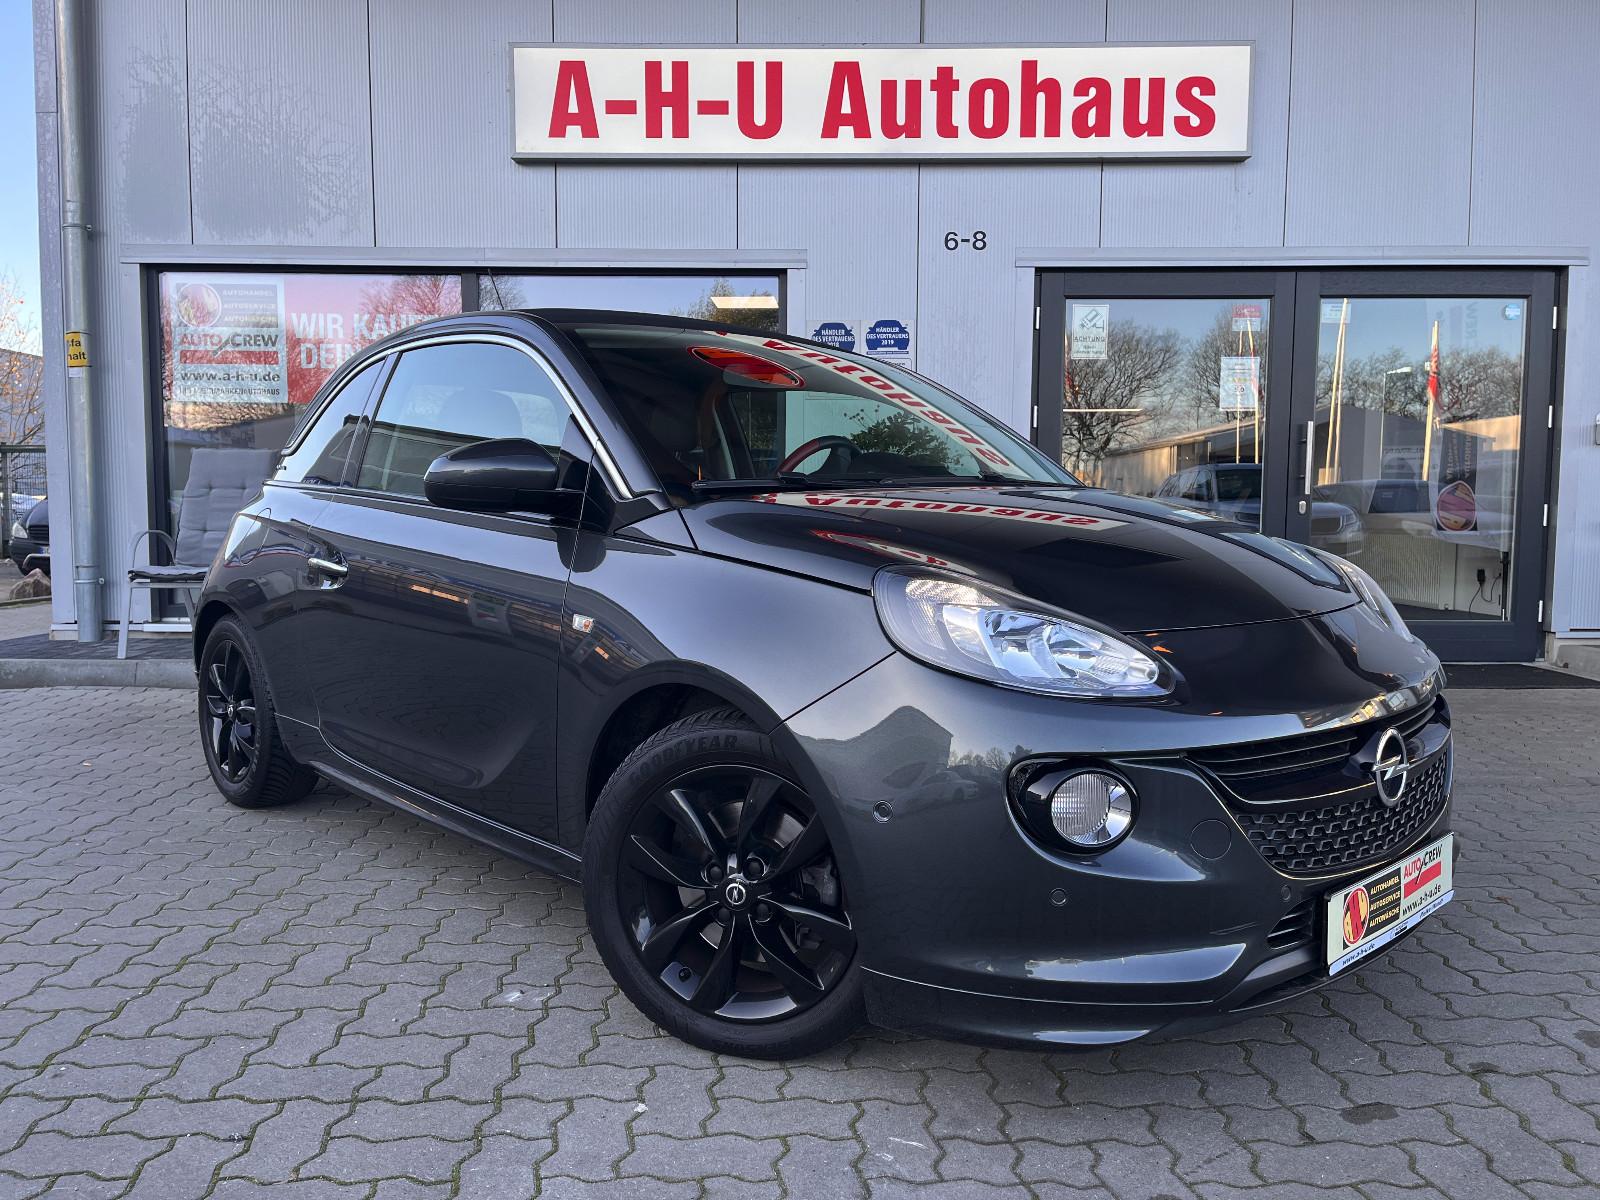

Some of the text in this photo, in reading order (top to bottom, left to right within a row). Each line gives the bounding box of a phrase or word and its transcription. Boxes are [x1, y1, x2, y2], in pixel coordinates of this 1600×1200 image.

[548, 59, 1216, 139] A-H-U Autohaus
[944, 230, 987, 251] 6-8
[291, 312, 344, 339] WIR
[821, 328, 845, 336] HÄNDLER
[180, 371, 280, 382] www.a-h-u.de
[1370, 875, 1400, 895] AUTOHANDEL
[1369, 890, 1402, 912] AUTOSERVICE
[1402, 884, 1443, 916] www.a-h-u.de
